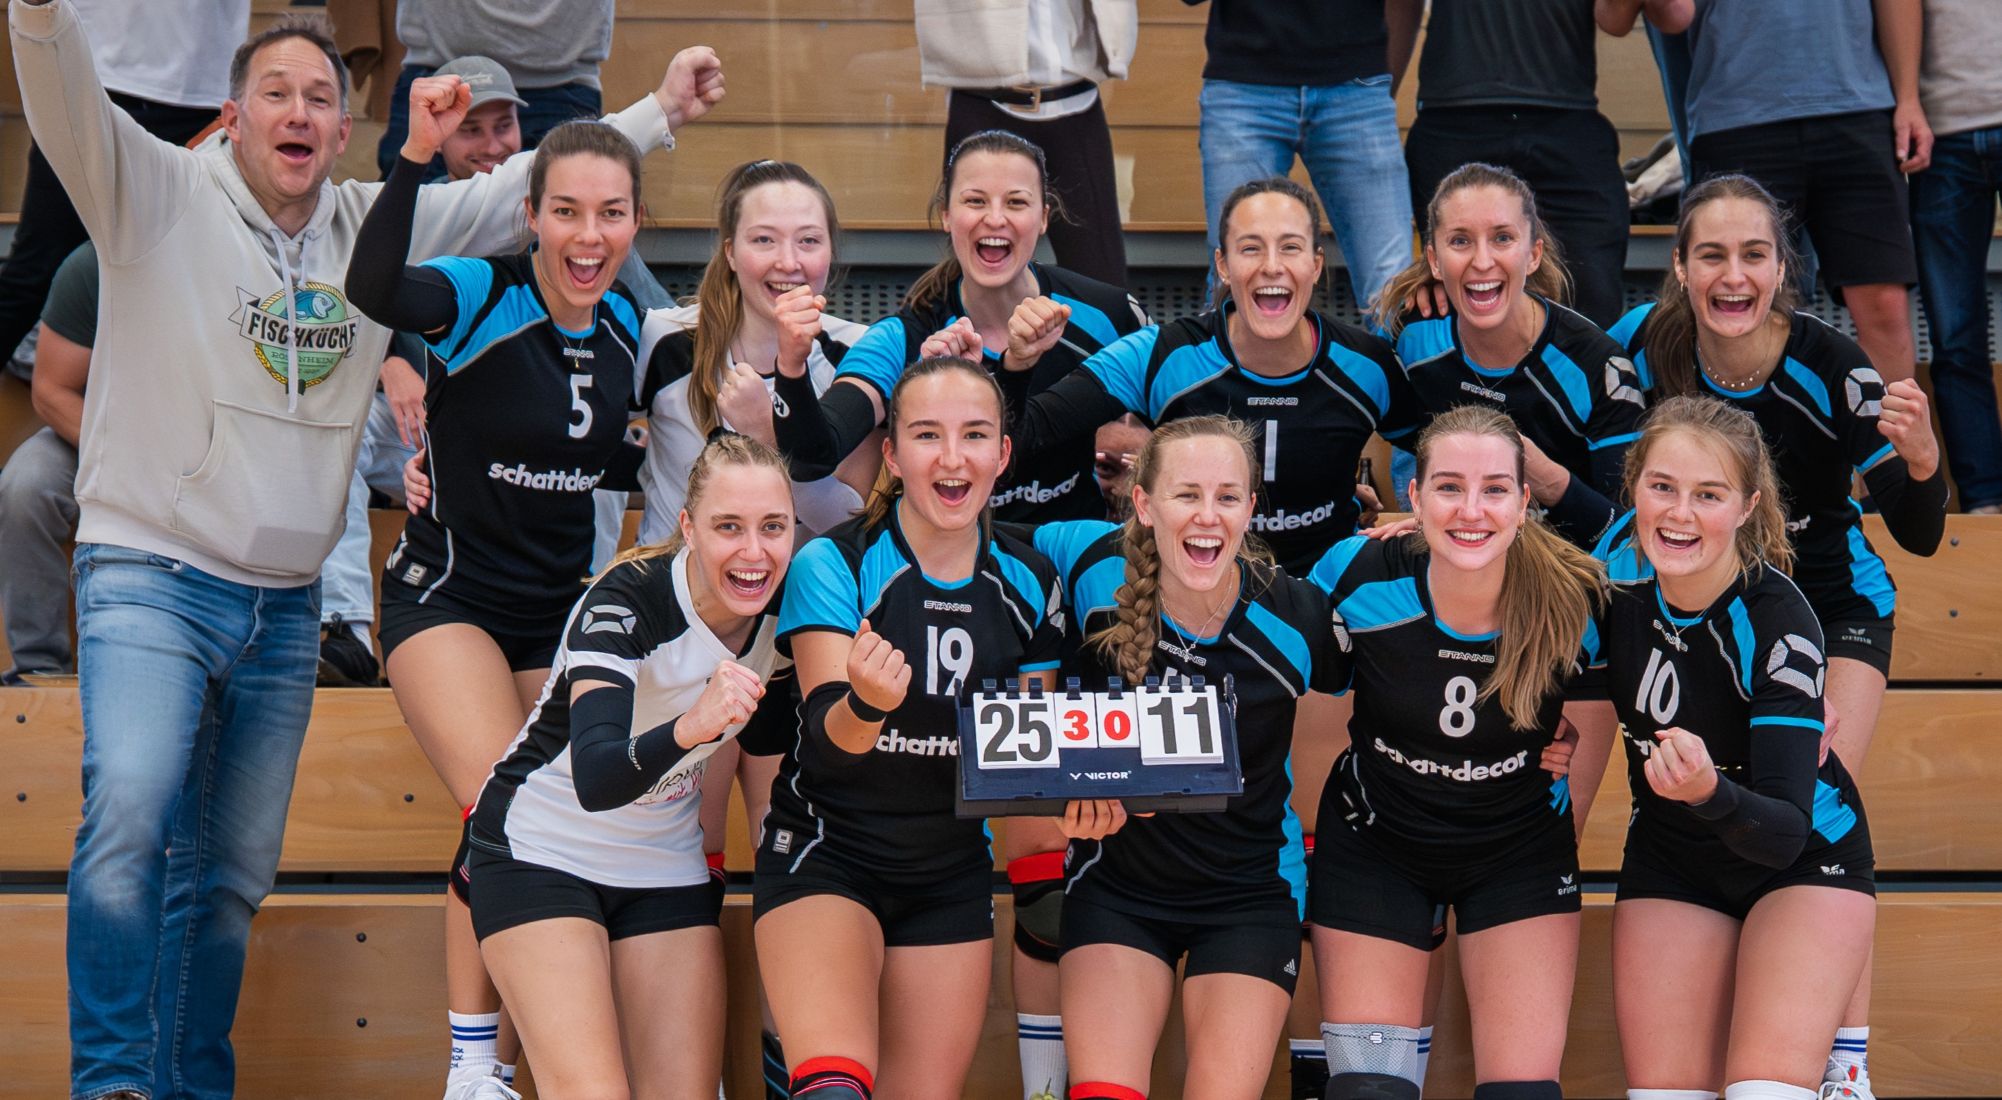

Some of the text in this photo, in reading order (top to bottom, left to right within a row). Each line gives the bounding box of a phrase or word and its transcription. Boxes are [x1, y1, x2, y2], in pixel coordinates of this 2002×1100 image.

[568, 374, 593, 439] 5
[1247, 397, 1299, 406] STANNO
[1264, 420, 1278, 482] 1
[989, 471, 1080, 508] attdecor
[924, 600, 973, 613] STANNO
[926, 625, 974, 696] 19
[1438, 649, 1495, 663] STANNO
[1635, 647, 1680, 725] 10
[980, 697, 1214, 762] 25 3 0 11
[1439, 676, 1477, 737] 8
[1085, 770, 1129, 780] VICTOR
